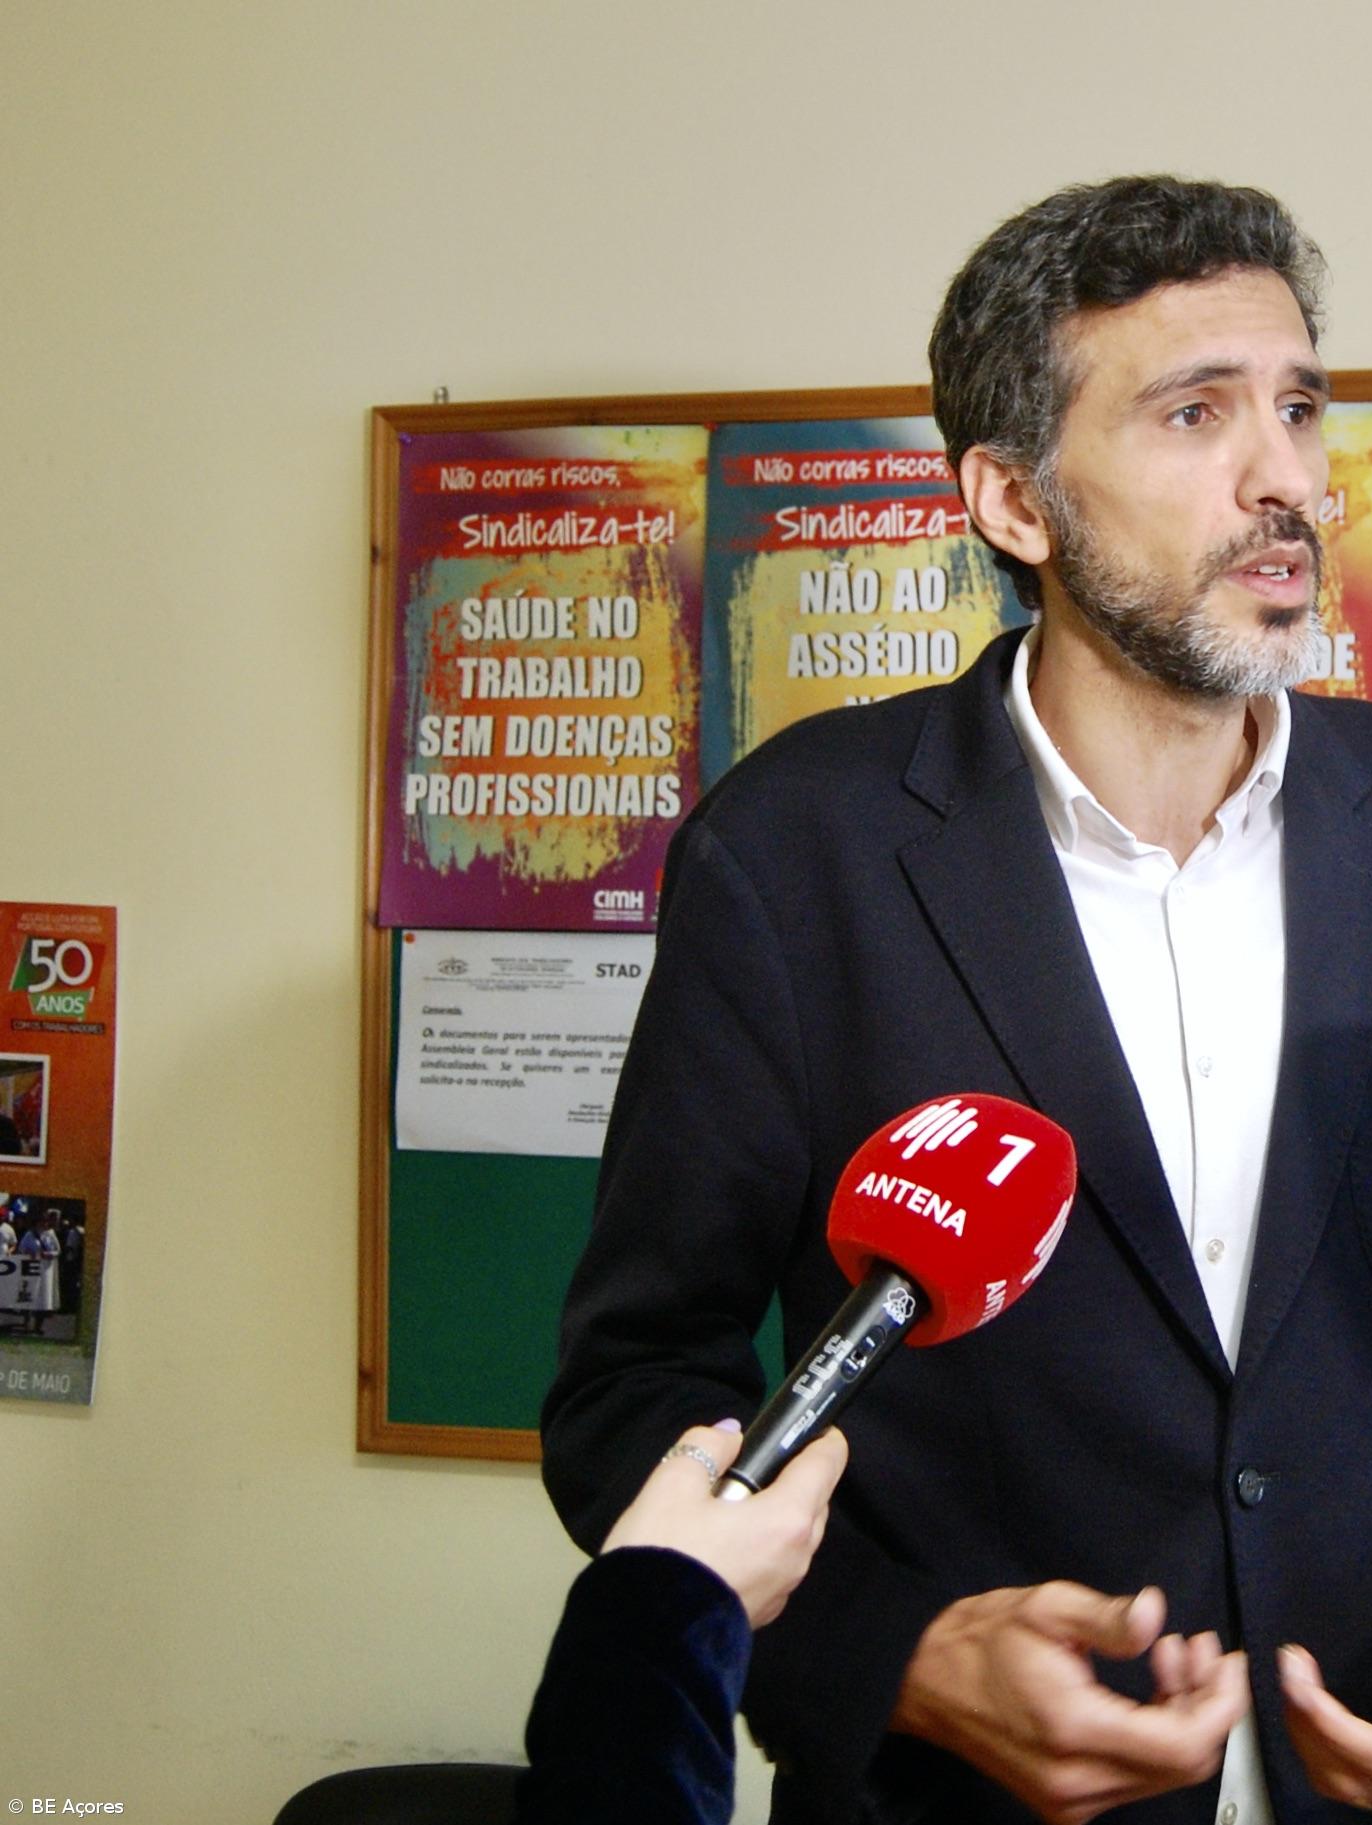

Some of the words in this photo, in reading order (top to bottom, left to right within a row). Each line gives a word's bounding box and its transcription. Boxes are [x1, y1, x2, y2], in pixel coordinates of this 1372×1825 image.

[440, 467, 475, 491] Não
[481, 466, 545, 489] corras
[754, 458, 793, 483] Não
[800, 456, 871, 481] corras
[458, 508, 675, 549] Sindicaliza-te!
[800, 560, 880, 615] NÃO
[893, 565, 949, 615] AO
[461, 589, 577, 641] SAÚDE
[588, 596, 640, 640] NO
[788, 623, 960, 679] ASSÉDIO
[457, 655, 644, 699] TRABALHO
[418, 715, 495, 758] SEM
[505, 714, 675, 767] DOENÇAS
[405, 772, 681, 818] PROFISSIONAIS
[593, 889, 644, 909] CIMH
[28, 938, 93, 994] 50
[596, 963, 642, 978] STAD
[36, 995, 85, 1015] ANOS
[439, 1028, 498, 1040] documentos
[530, 1031, 561, 1041] serem
[855, 1172, 967, 1238] ANTENA
[7, 1370, 28, 1390] DE
[32, 1373, 71, 1393] MAIO
